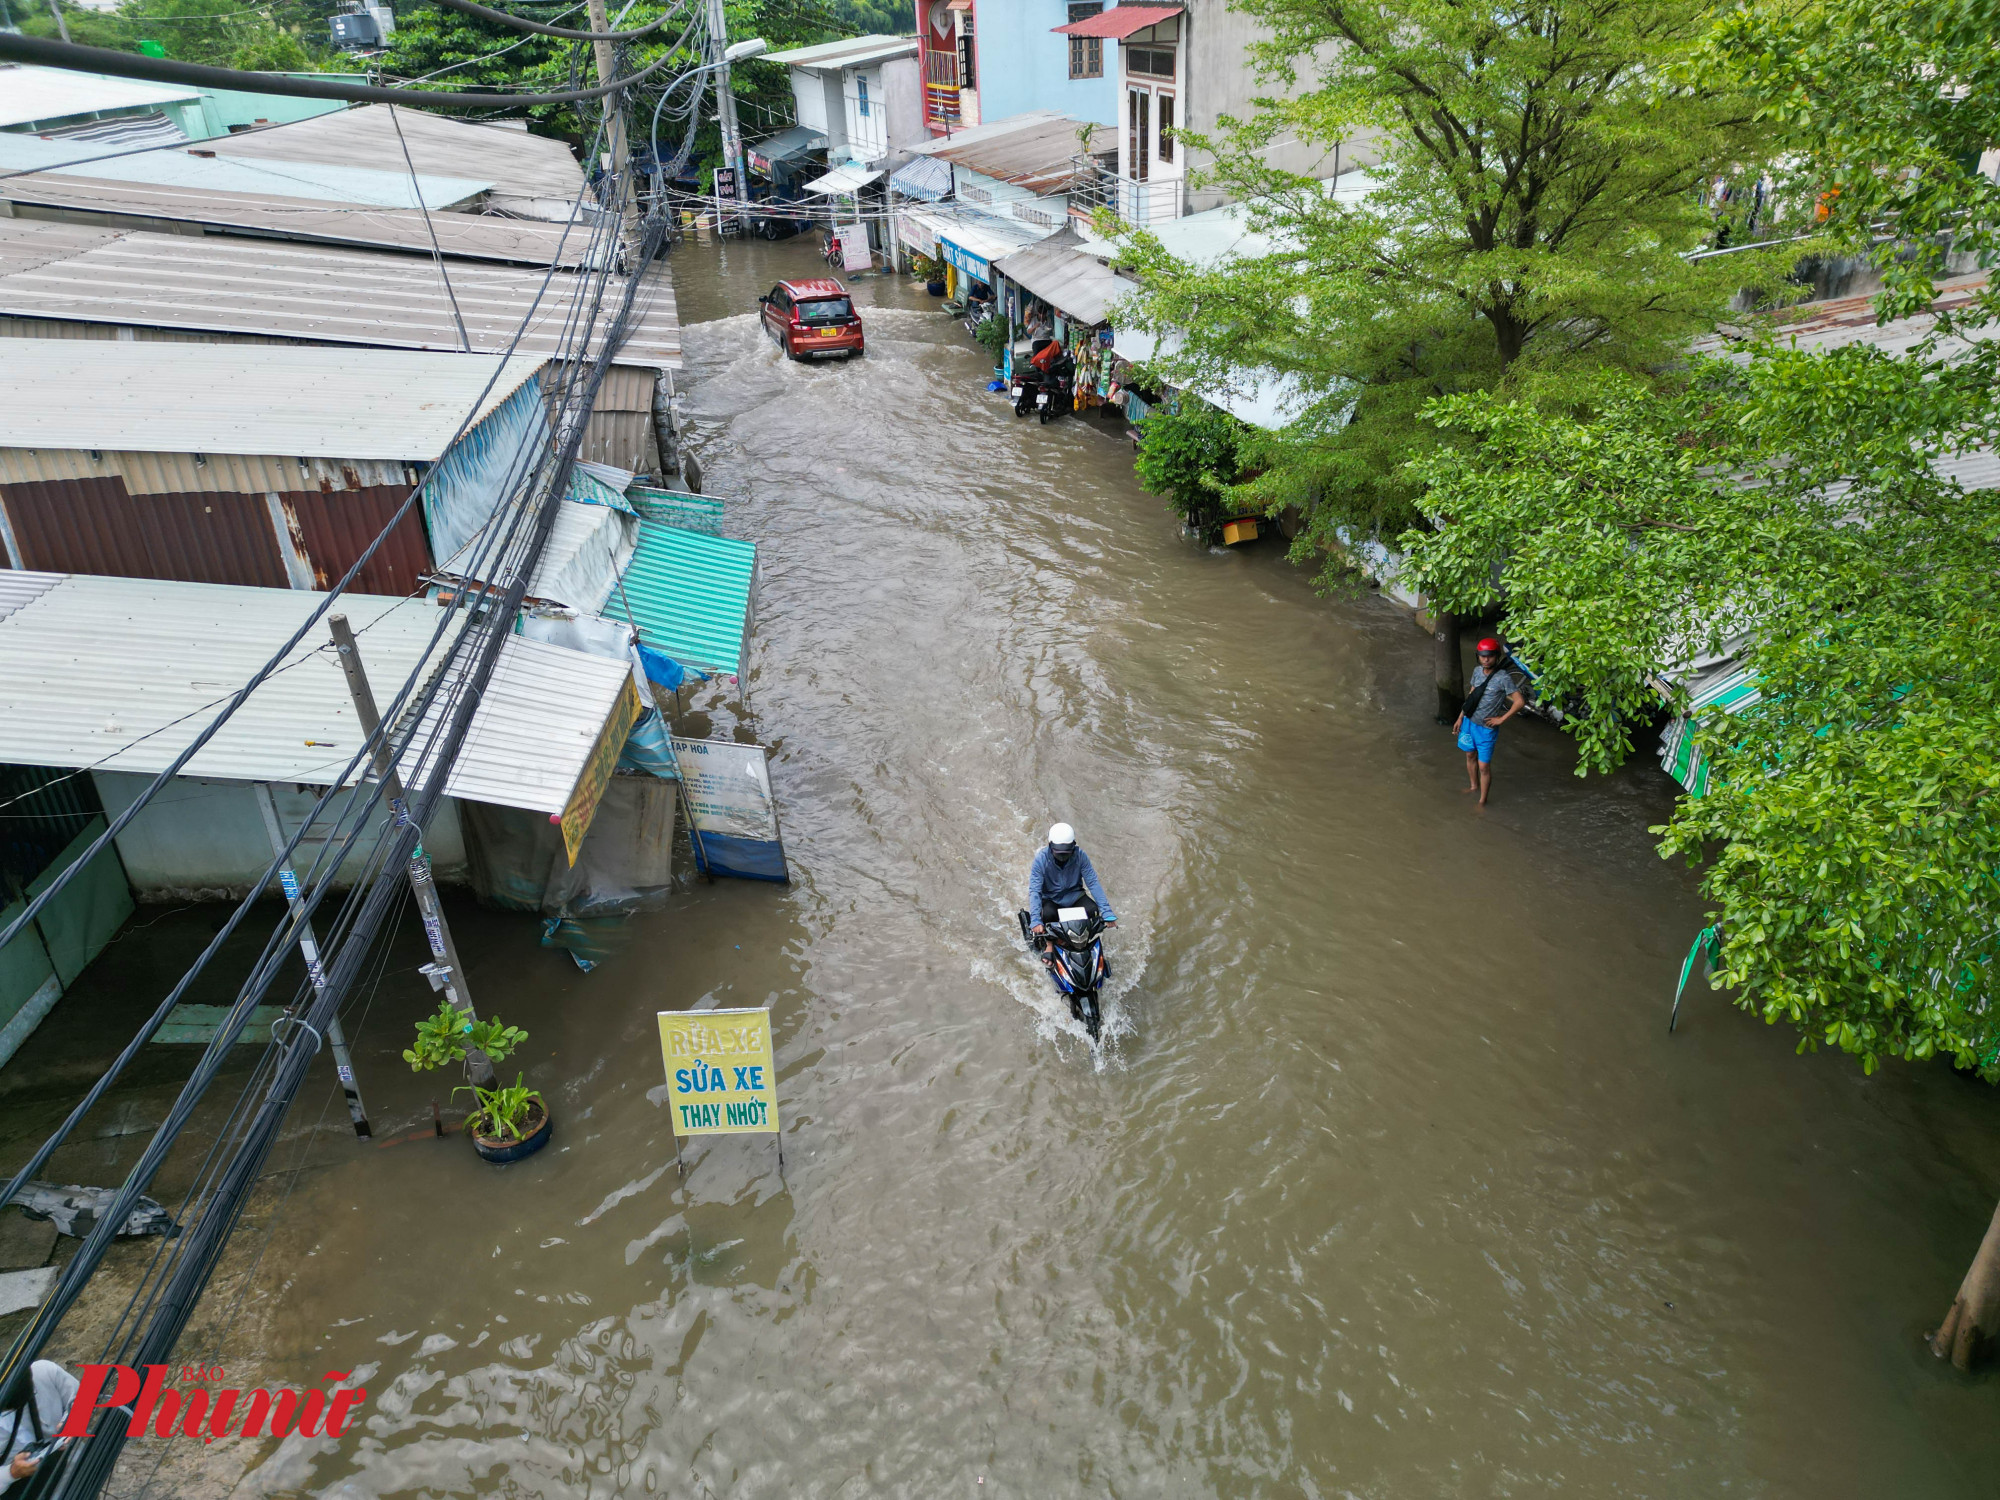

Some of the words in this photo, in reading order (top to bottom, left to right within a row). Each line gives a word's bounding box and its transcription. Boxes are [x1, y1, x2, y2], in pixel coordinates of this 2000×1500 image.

[671, 741, 688, 753] TẠP
[668, 1020, 724, 1057] RỬA
[728, 1026, 764, 1054] XE
[675, 1058, 727, 1093] SỬA
[732, 1066, 766, 1091] XE
[679, 1103, 722, 1129] THAY
[725, 1095, 768, 1127] NHỚT
